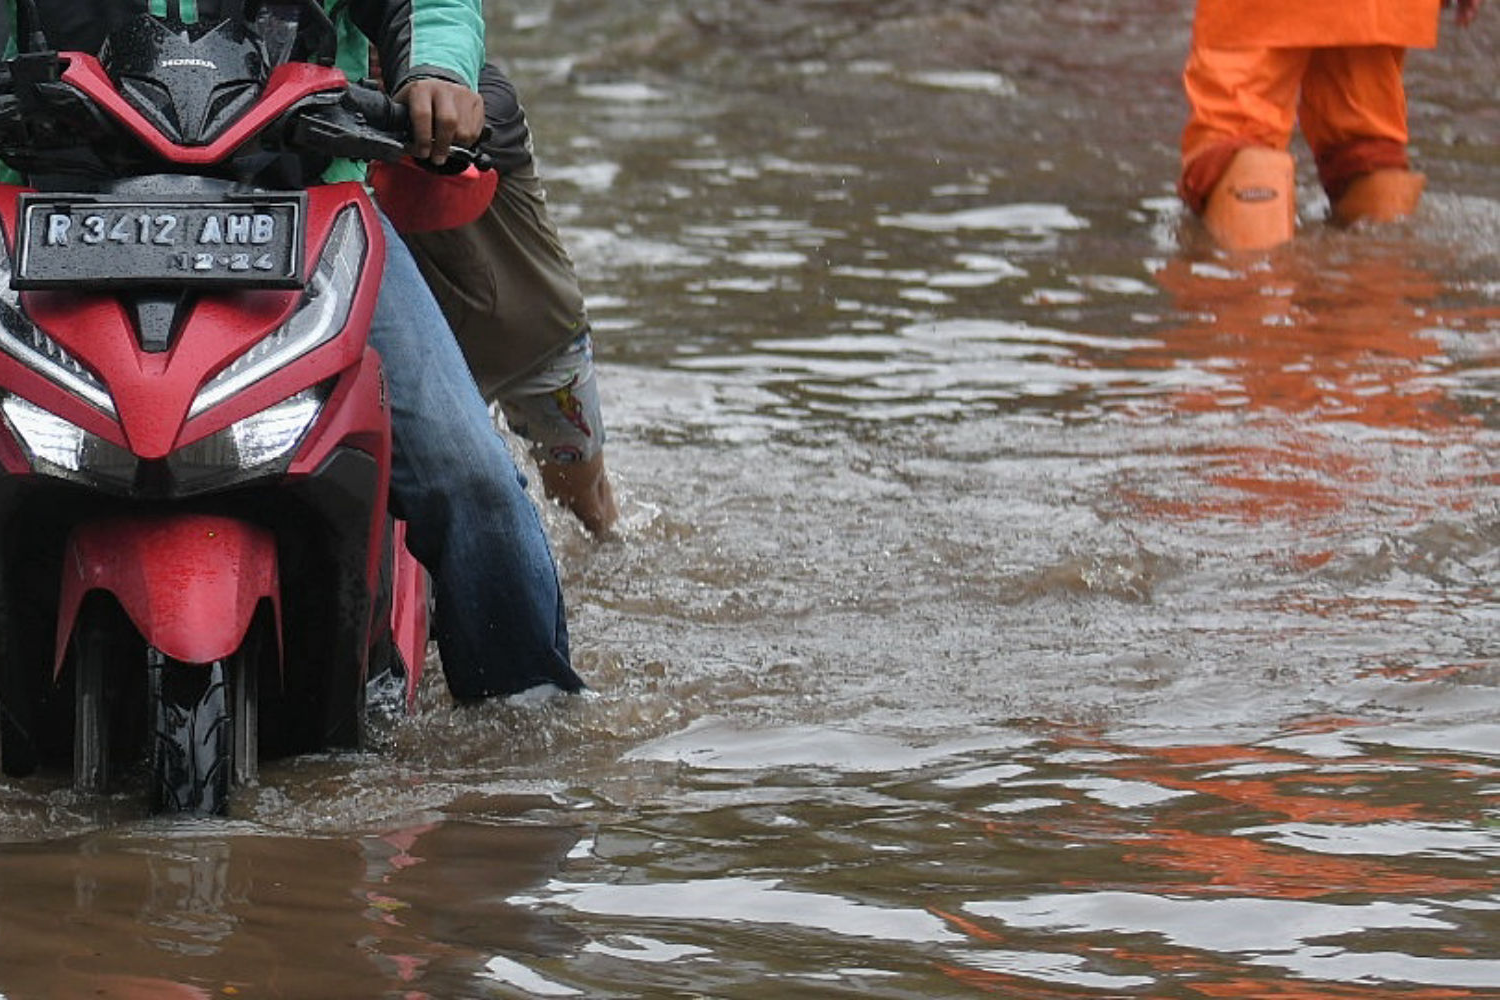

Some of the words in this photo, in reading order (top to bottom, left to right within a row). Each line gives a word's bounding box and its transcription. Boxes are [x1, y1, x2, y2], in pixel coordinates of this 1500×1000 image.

[161, 58, 218, 69] HONDA
[48, 213, 73, 246] R
[81, 213, 180, 245] 3412
[199, 214, 275, 245] AHB
